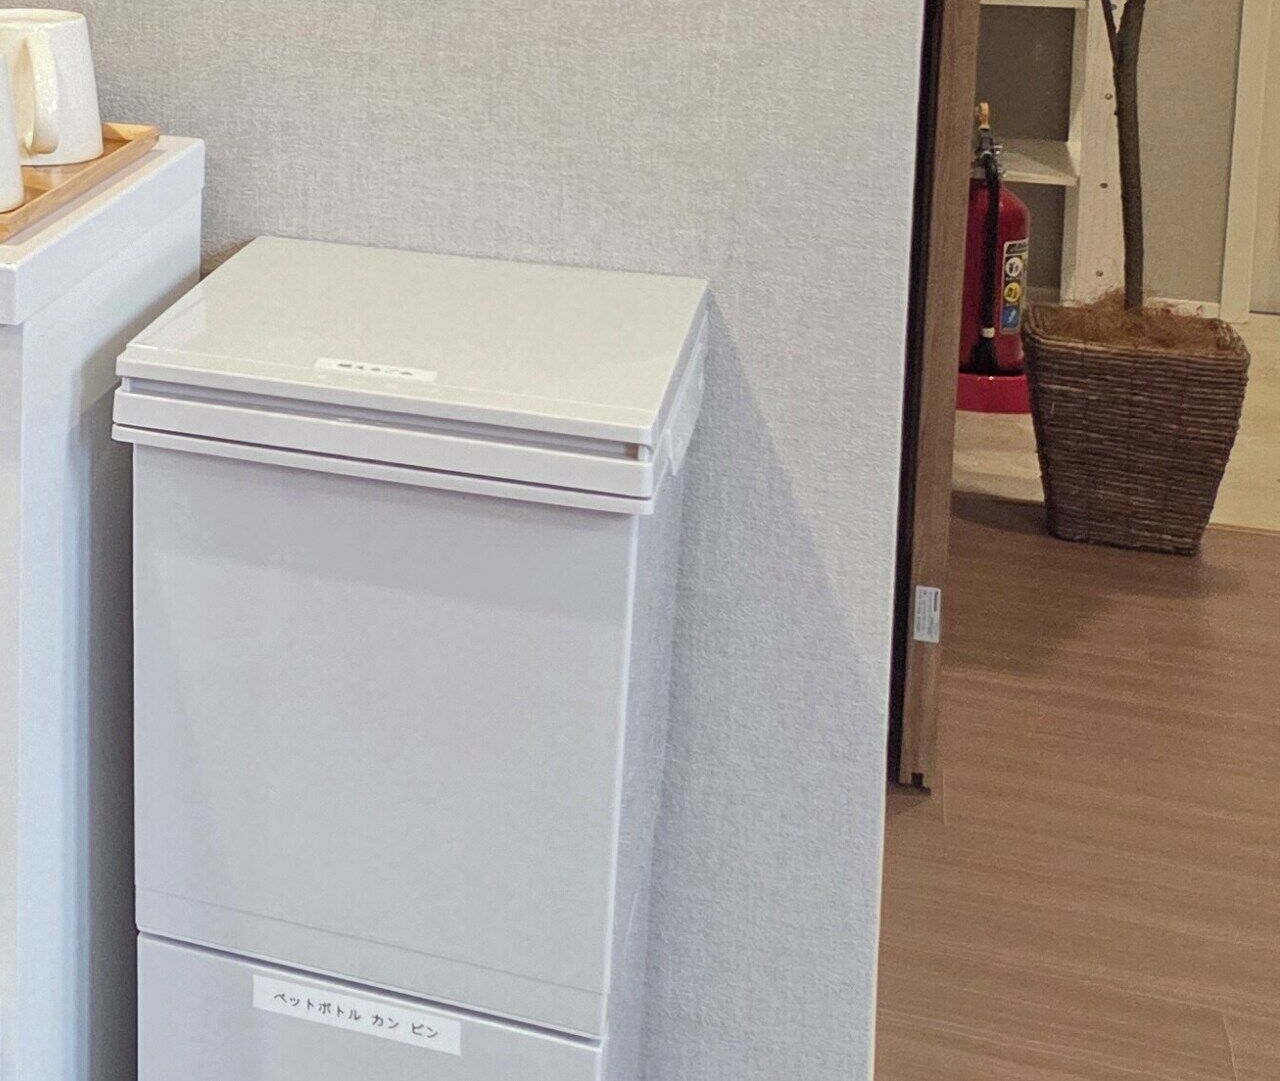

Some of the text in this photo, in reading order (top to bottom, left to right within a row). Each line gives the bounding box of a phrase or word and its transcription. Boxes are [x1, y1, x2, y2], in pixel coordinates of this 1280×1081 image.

[273, 992, 362, 1021] ペットボトル
[371, 1013, 400, 1029] カン
